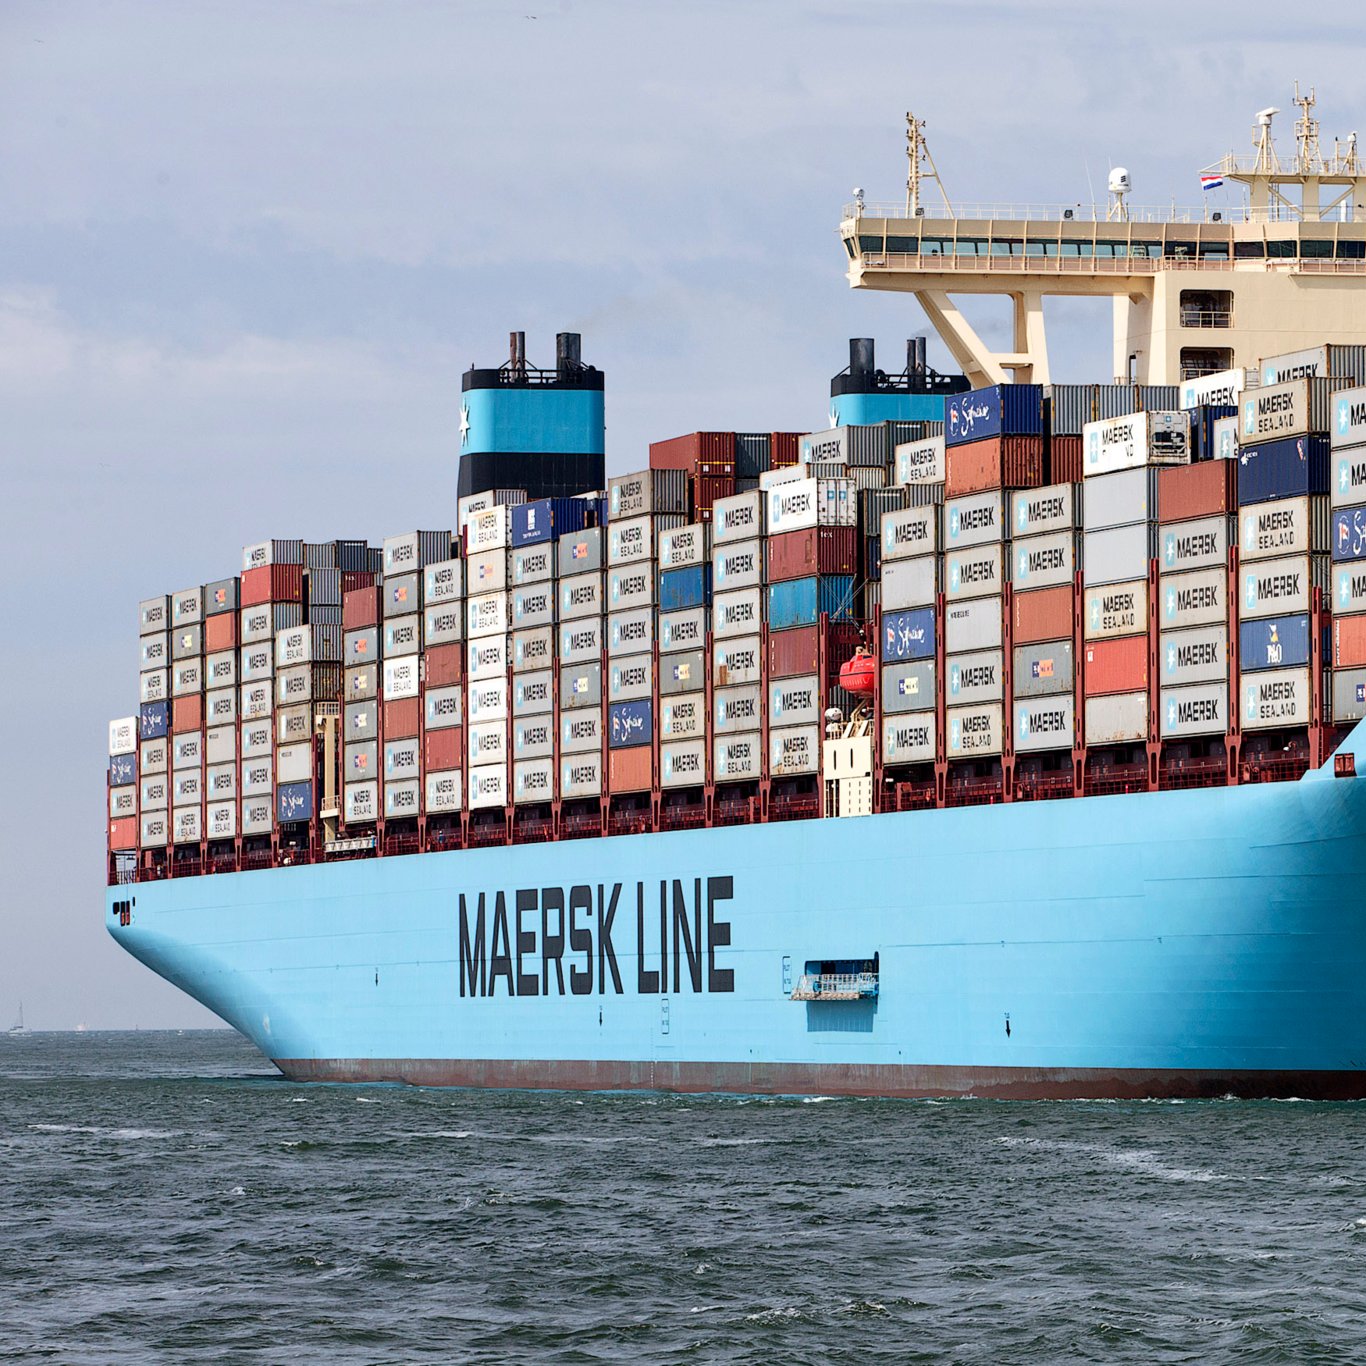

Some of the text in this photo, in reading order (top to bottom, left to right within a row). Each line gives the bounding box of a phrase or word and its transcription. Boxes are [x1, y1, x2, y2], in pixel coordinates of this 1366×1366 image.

[1197, 386, 1235, 405] MAERSK
[1258, 392, 1294, 416] MAERSK
[1258, 413, 1295, 433] SEALAND
[1102, 423, 1134, 446] MAERSK
[811, 440, 841, 462] MAERSK
[910, 447, 936, 466] MAERSK
[620, 481, 643, 499] MAERSK
[781, 493, 811, 516] MAERSK
[1028, 497, 1065, 522] MAERSK
[725, 505, 754, 528] MAERSK
[960, 506, 995, 527] MAERSK
[1258, 510, 1294, 532] MAERSK
[620, 526, 643, 543] MAERSK
[671, 532, 694, 548] MAERSK
[895, 520, 928, 544] MAERSK
[1258, 531, 1295, 549] SEALAND
[392, 544, 414, 563] MAERSK
[1177, 532, 1218, 559] MAERSK
[522, 553, 547, 573] MAERSK
[725, 554, 754, 577] MAERSK
[1029, 548, 1065, 572] MAERSK
[960, 560, 995, 582] MAERSK
[619, 575, 646, 595] MAERSK
[1258, 573, 1300, 595] MAERSK
[570, 585, 596, 604] MAERSK
[1102, 593, 1134, 613] MAERSK
[1177, 585, 1218, 611] MAERSK
[522, 595, 547, 614] MAERSK
[725, 602, 754, 623] MAERSK
[434, 613, 457, 630] MAERSK
[670, 621, 698, 640] MAERSK
[1102, 613, 1135, 630] SEALAND
[392, 626, 414, 643] MAERSK
[570, 631, 596, 650] MAERSK
[619, 621, 646, 642] MAERSK
[478, 648, 501, 665] MAERSK
[522, 639, 547, 656] MAERSK
[1177, 642, 1218, 667] MAERSK
[726, 650, 755, 671] MAERSK
[619, 667, 647, 687] MAERSK
[961, 665, 995, 688] MAERSK
[478, 691, 501, 708] MAERSK
[523, 683, 548, 701] MAERSK
[782, 690, 812, 710] MAERSK
[1259, 681, 1295, 701] MAERSK
[434, 698, 457, 714] MAERSK
[672, 703, 695, 719] MAERSK
[726, 698, 755, 719] MAERSK
[1178, 699, 1218, 723] MAERSK
[1259, 702, 1296, 719] SEALAND
[570, 720, 597, 739] MAERSK
[962, 714, 991, 733] MAERSK
[1029, 711, 1066, 733] MAERSK
[478, 734, 501, 751] MAERSK
[523, 727, 548, 744] MAERSK
[783, 736, 808, 752] MAERSK
[896, 726, 929, 748] MAERSK
[962, 733, 992, 748] SEALAND
[393, 751, 414, 767] MAERSK
[727, 743, 751, 757] MAERSK
[672, 753, 700, 772] MAERSK
[478, 776, 501, 793] MAERSK
[523, 771, 548, 789] MAERSK
[570, 766, 597, 784] MAERSK
[393, 790, 415, 807] MAERSK
[459, 875, 735, 998] MAERSK LINE
